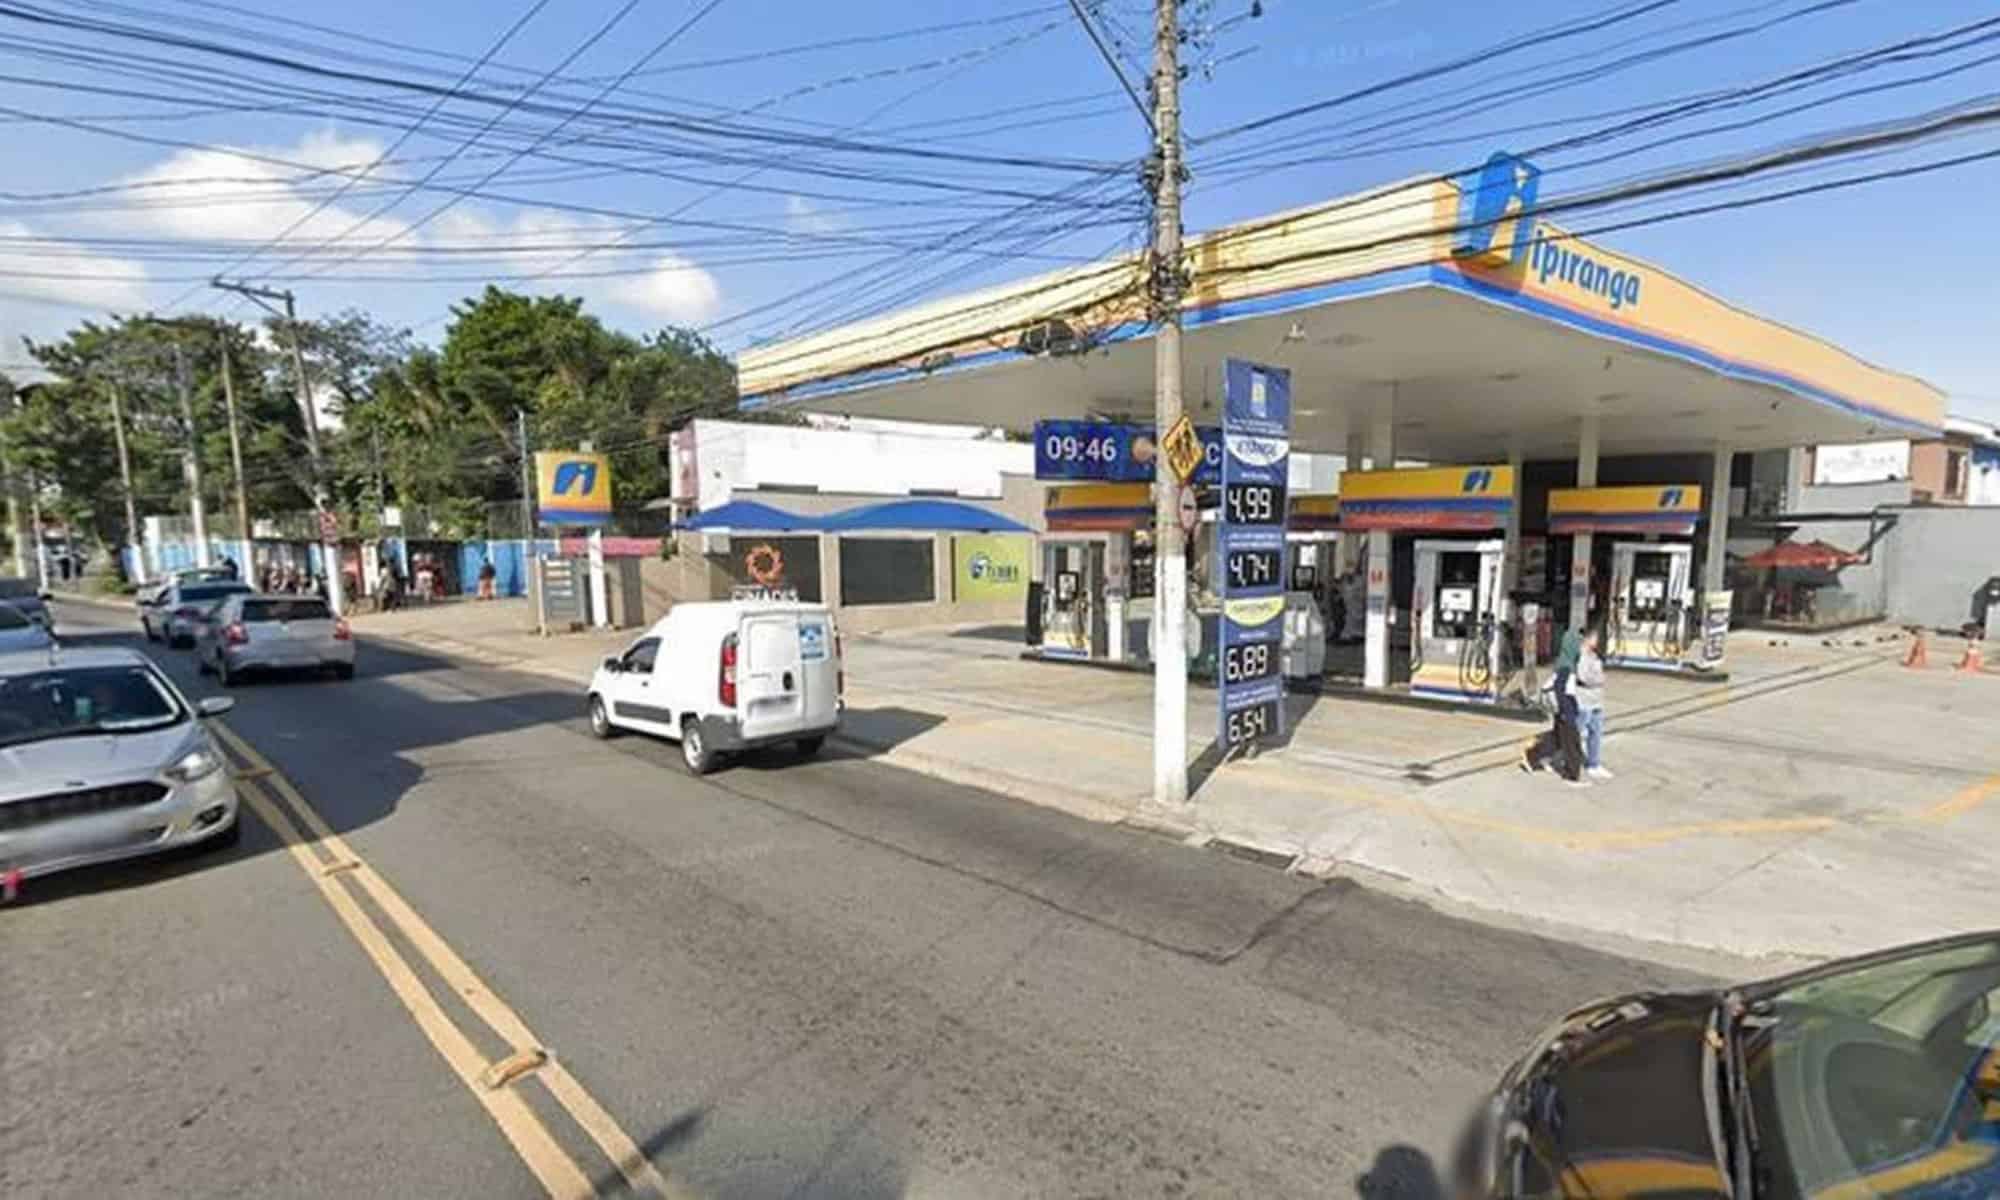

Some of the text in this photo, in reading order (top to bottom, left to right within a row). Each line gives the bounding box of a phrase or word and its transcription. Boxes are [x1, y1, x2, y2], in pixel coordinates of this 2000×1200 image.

[1531, 228, 1641, 310] ipiranga
[1045, 436, 1118, 463] 09:46
[1228, 488, 1272, 523] 4,99
[1230, 553, 1271, 586] 4,74
[1226, 644, 1269, 681] 6,89
